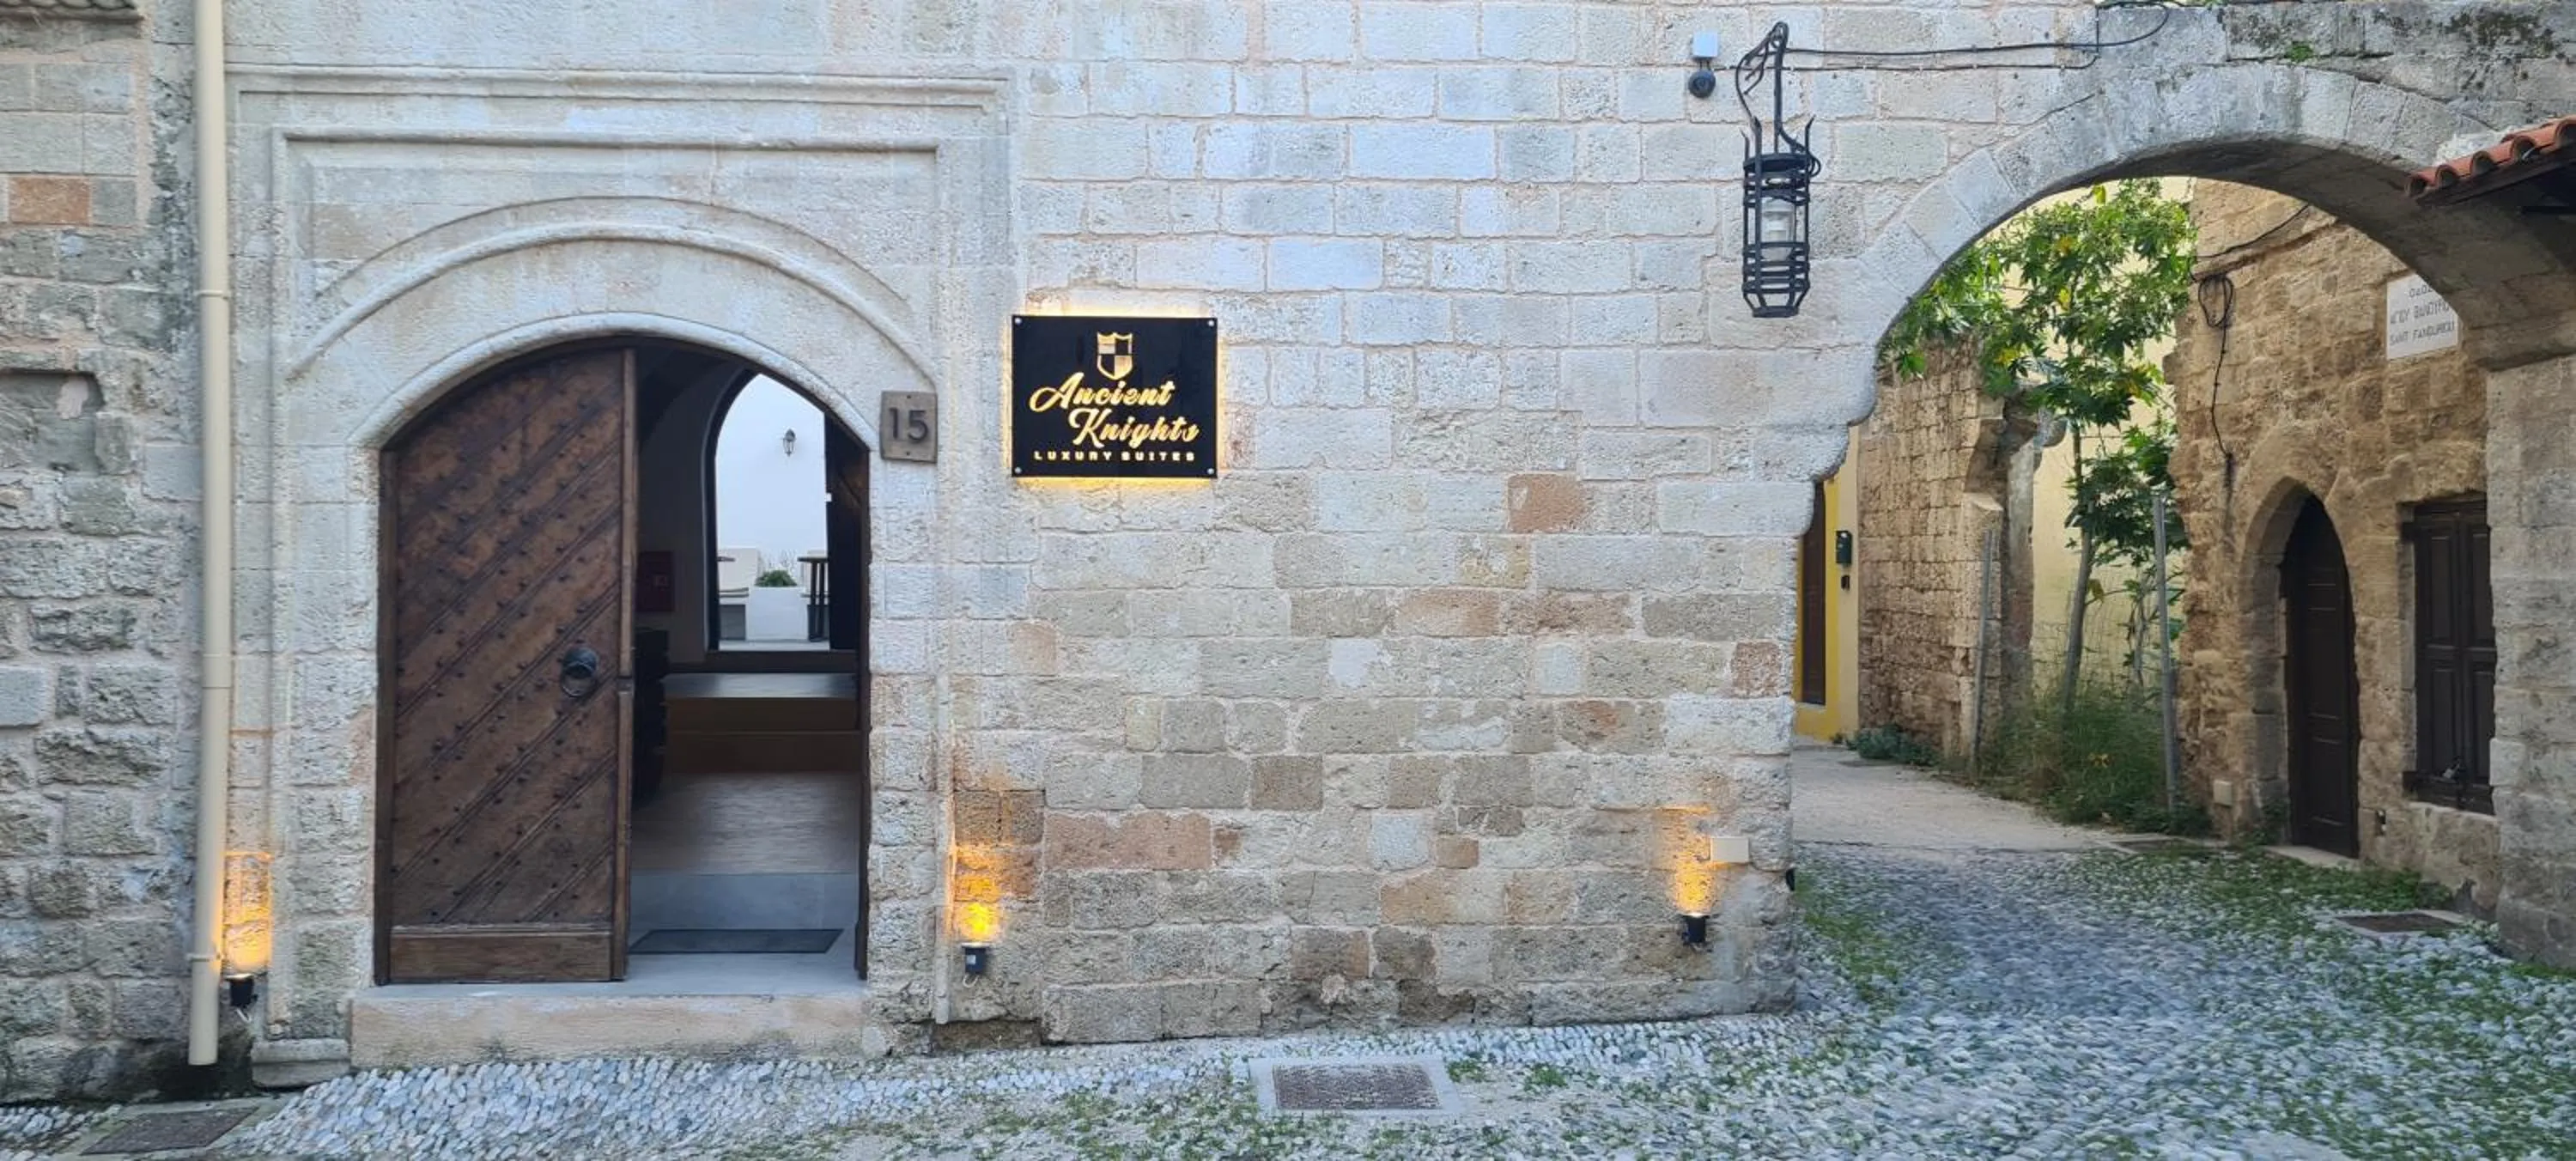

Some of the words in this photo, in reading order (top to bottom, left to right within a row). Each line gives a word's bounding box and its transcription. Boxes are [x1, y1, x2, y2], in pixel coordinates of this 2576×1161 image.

[1029, 371, 1176, 413] Ancient
[888, 407, 929, 443] 15
[1067, 408, 1200, 449] Knights
[1033, 451, 1112, 461] LUXURY
[1121, 451, 1195, 462] SUITES
